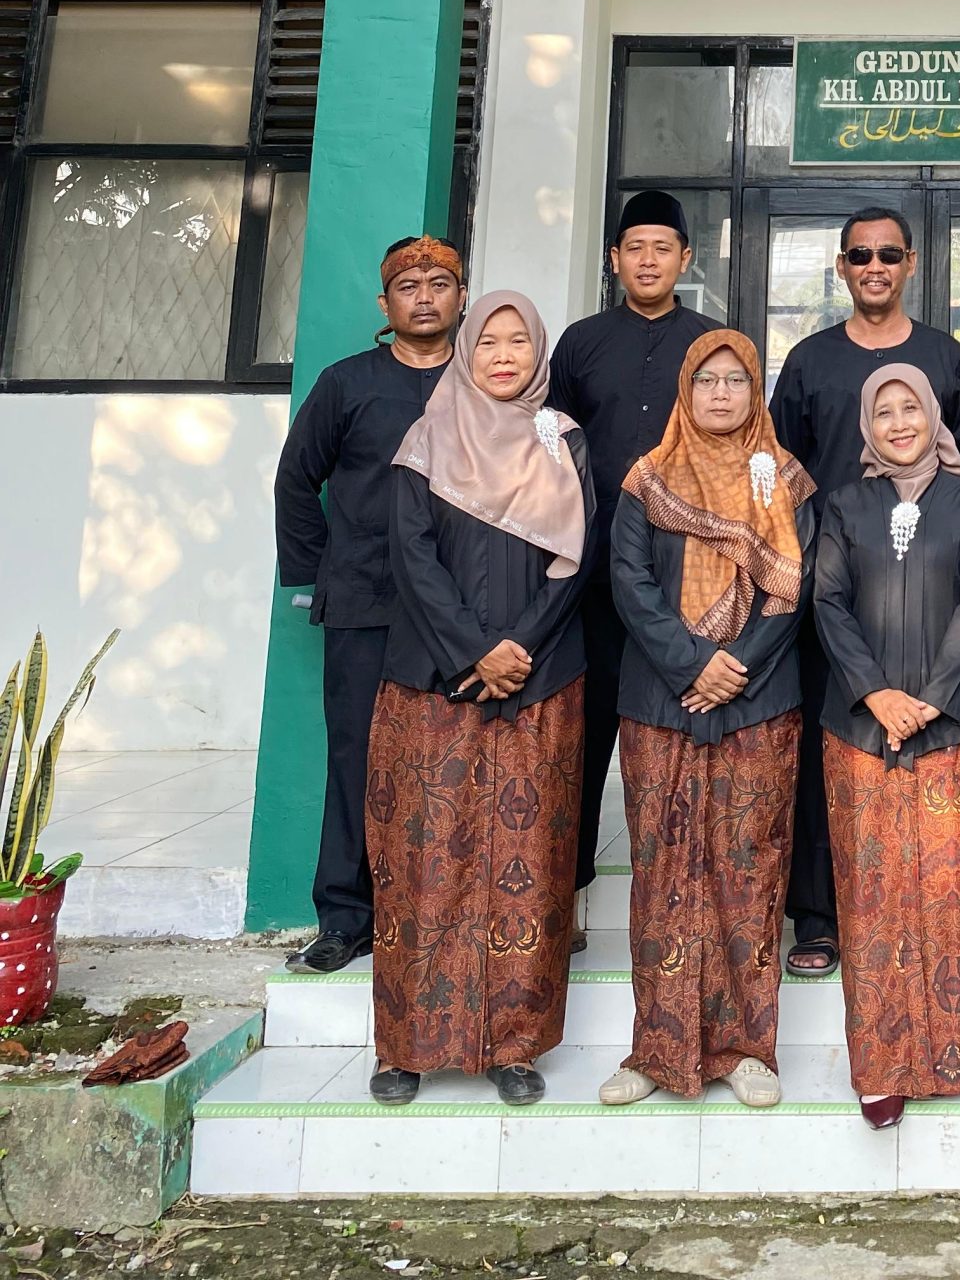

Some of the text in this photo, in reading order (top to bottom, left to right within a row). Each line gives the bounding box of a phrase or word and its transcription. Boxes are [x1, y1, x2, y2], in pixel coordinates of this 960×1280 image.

[824, 79, 864, 102] KH.
[871, 79, 951, 102] ABDUL
[404, 453, 425, 468] ONEL
[442, 485, 466, 502] MONEL
